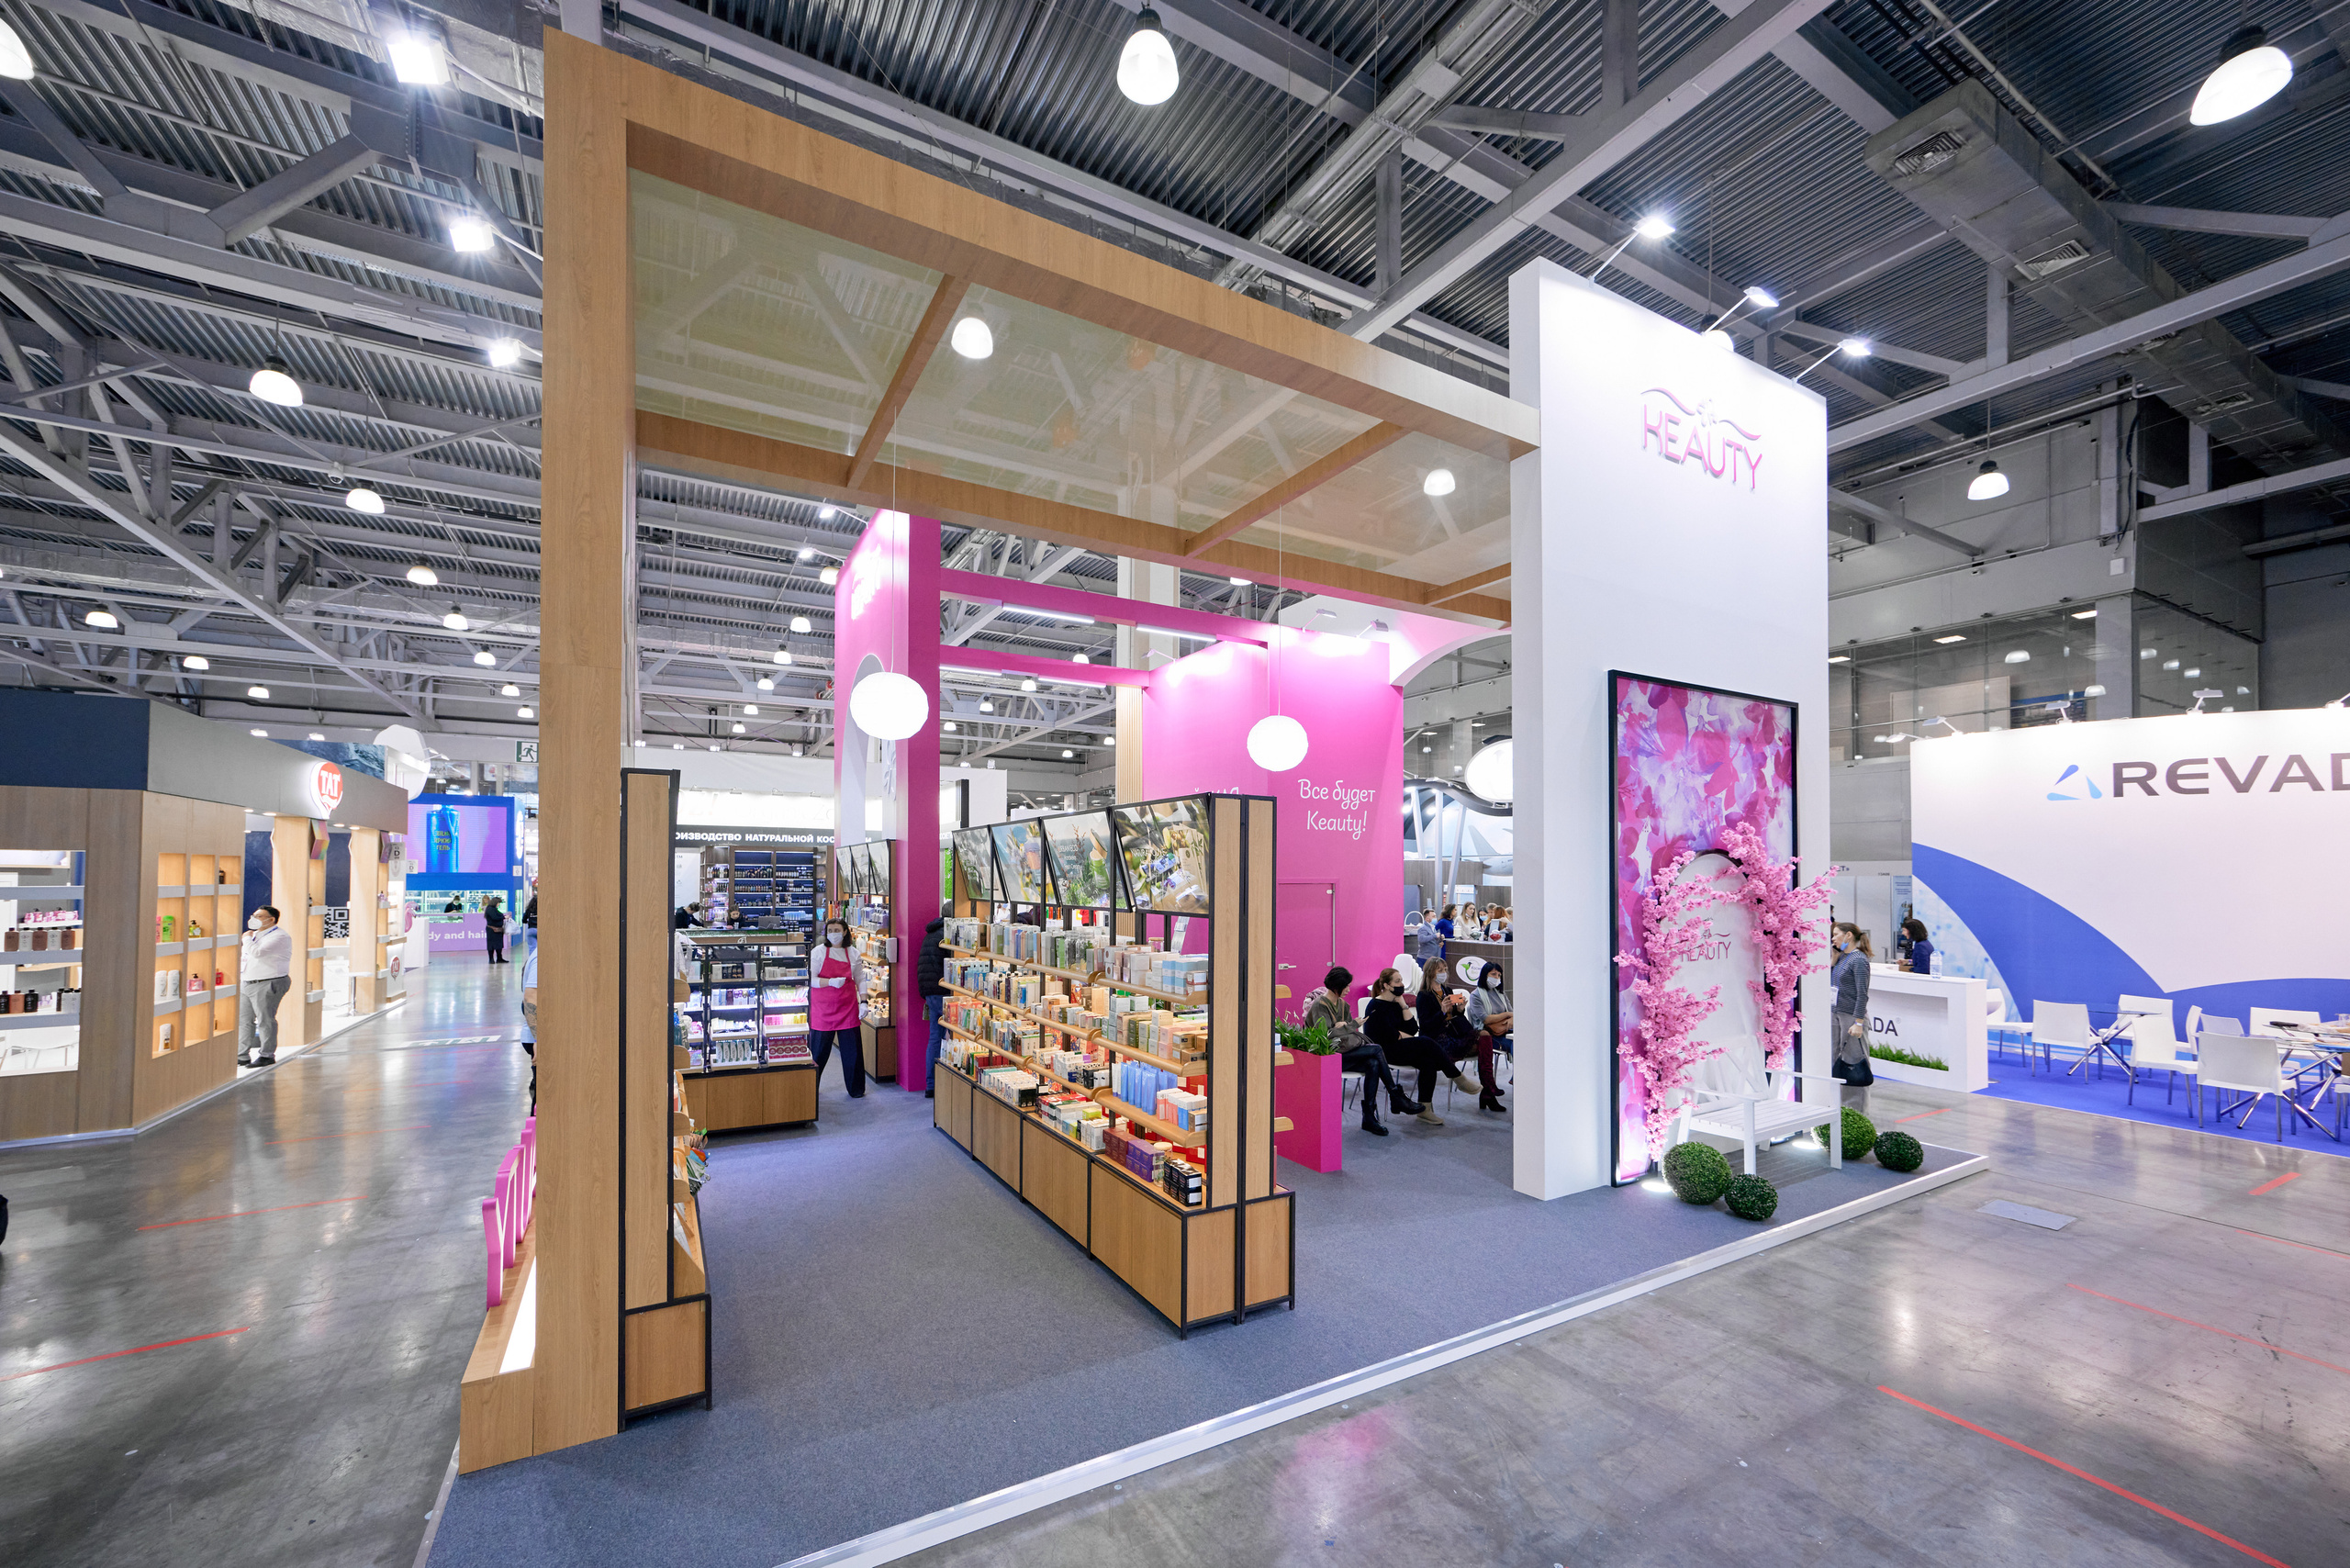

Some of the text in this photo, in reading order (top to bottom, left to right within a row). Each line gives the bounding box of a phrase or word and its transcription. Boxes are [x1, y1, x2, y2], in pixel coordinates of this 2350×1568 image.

[1643, 404, 1763, 490] KEAUTY
[1298, 778, 1376, 810] Все будет
[1307, 811, 1368, 840] Keauty!
[745, 834, 814, 844] НАТУРАЛЬНОЙ
[443, 931, 464, 940] and
[1868, 1016, 1898, 1036] DA
